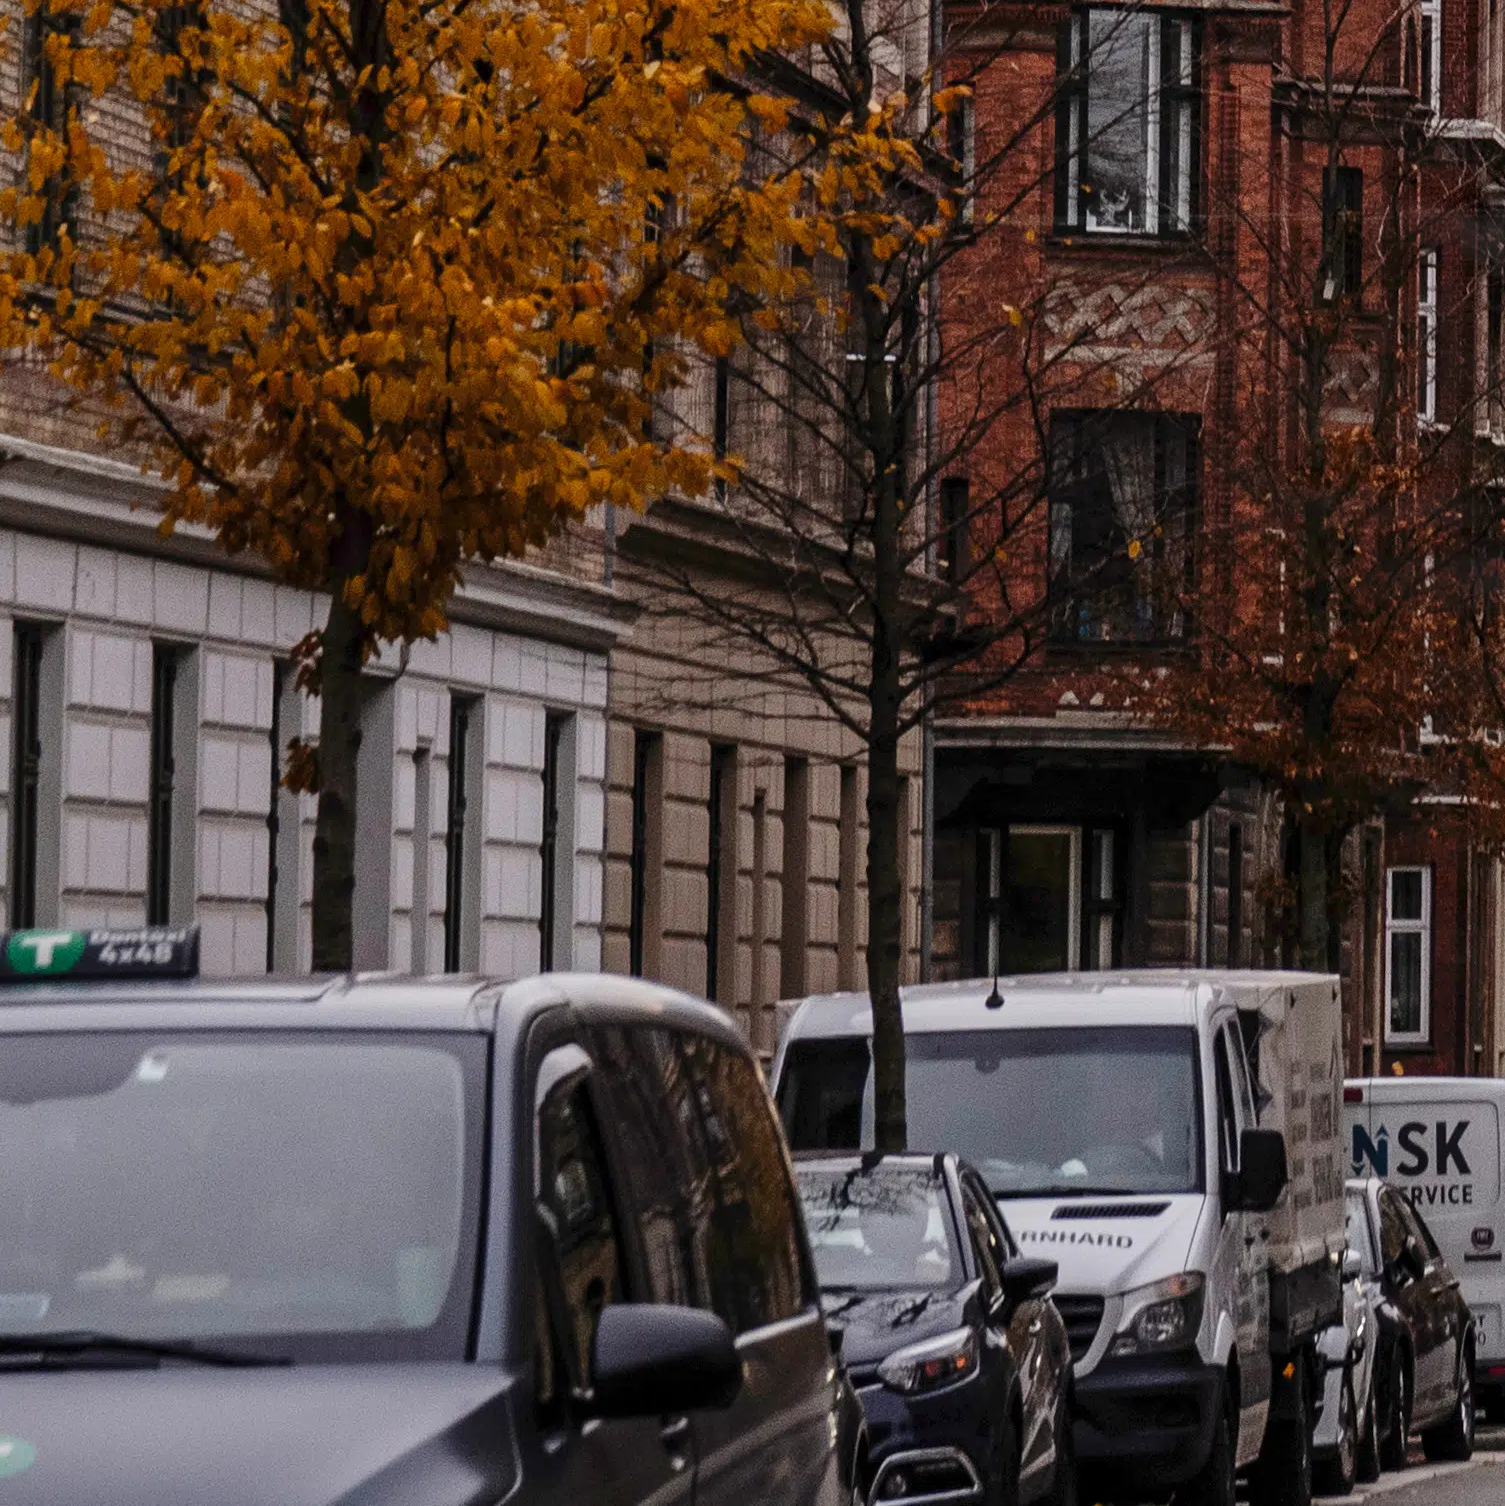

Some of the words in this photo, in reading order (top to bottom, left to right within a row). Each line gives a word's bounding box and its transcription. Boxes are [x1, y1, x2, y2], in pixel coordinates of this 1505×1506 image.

[21, 932, 73, 970] T
[1351, 1120, 1472, 1177] NSK
[1403, 1184, 1473, 1205] RVICE
[1013, 1229, 1133, 1249] RNHARD
